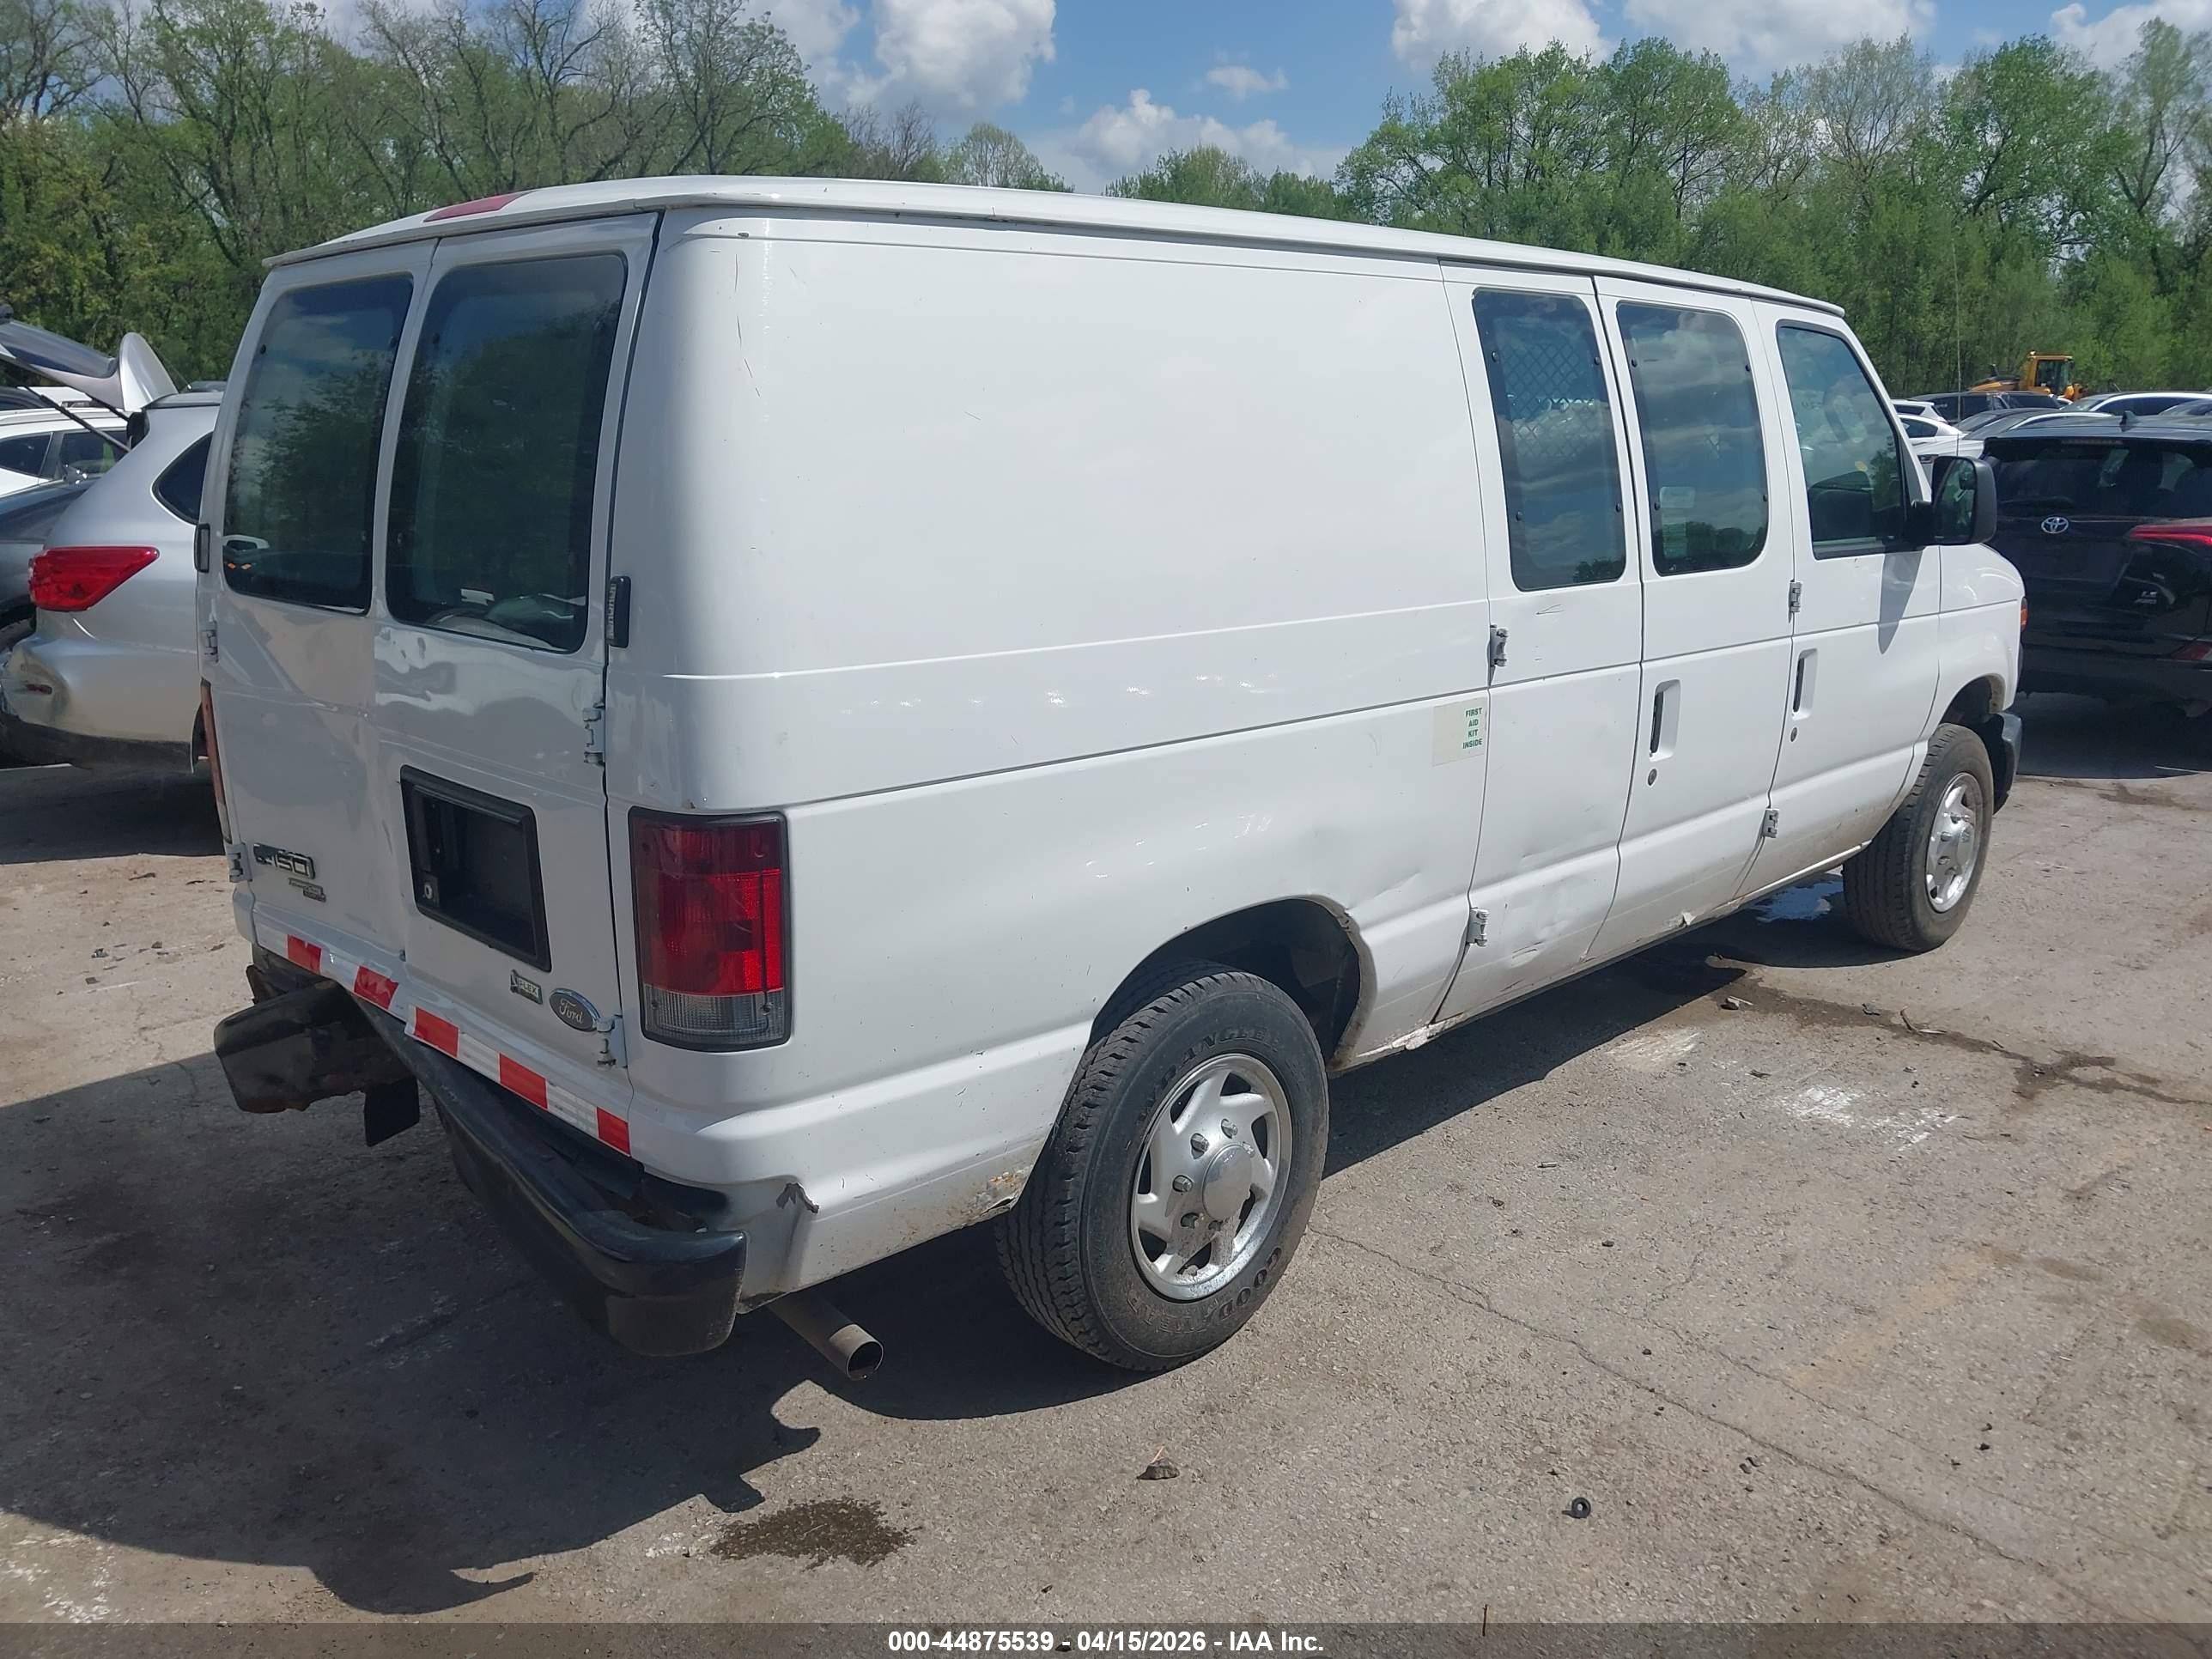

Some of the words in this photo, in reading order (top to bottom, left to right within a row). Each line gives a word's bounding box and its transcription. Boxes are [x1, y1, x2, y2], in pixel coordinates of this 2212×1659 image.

[1465, 708, 1483, 718] FIRST
[1468, 719, 1479, 727] AID
[1468, 729, 1479, 738] KIT
[1462, 738, 1483, 749] INSIDE
